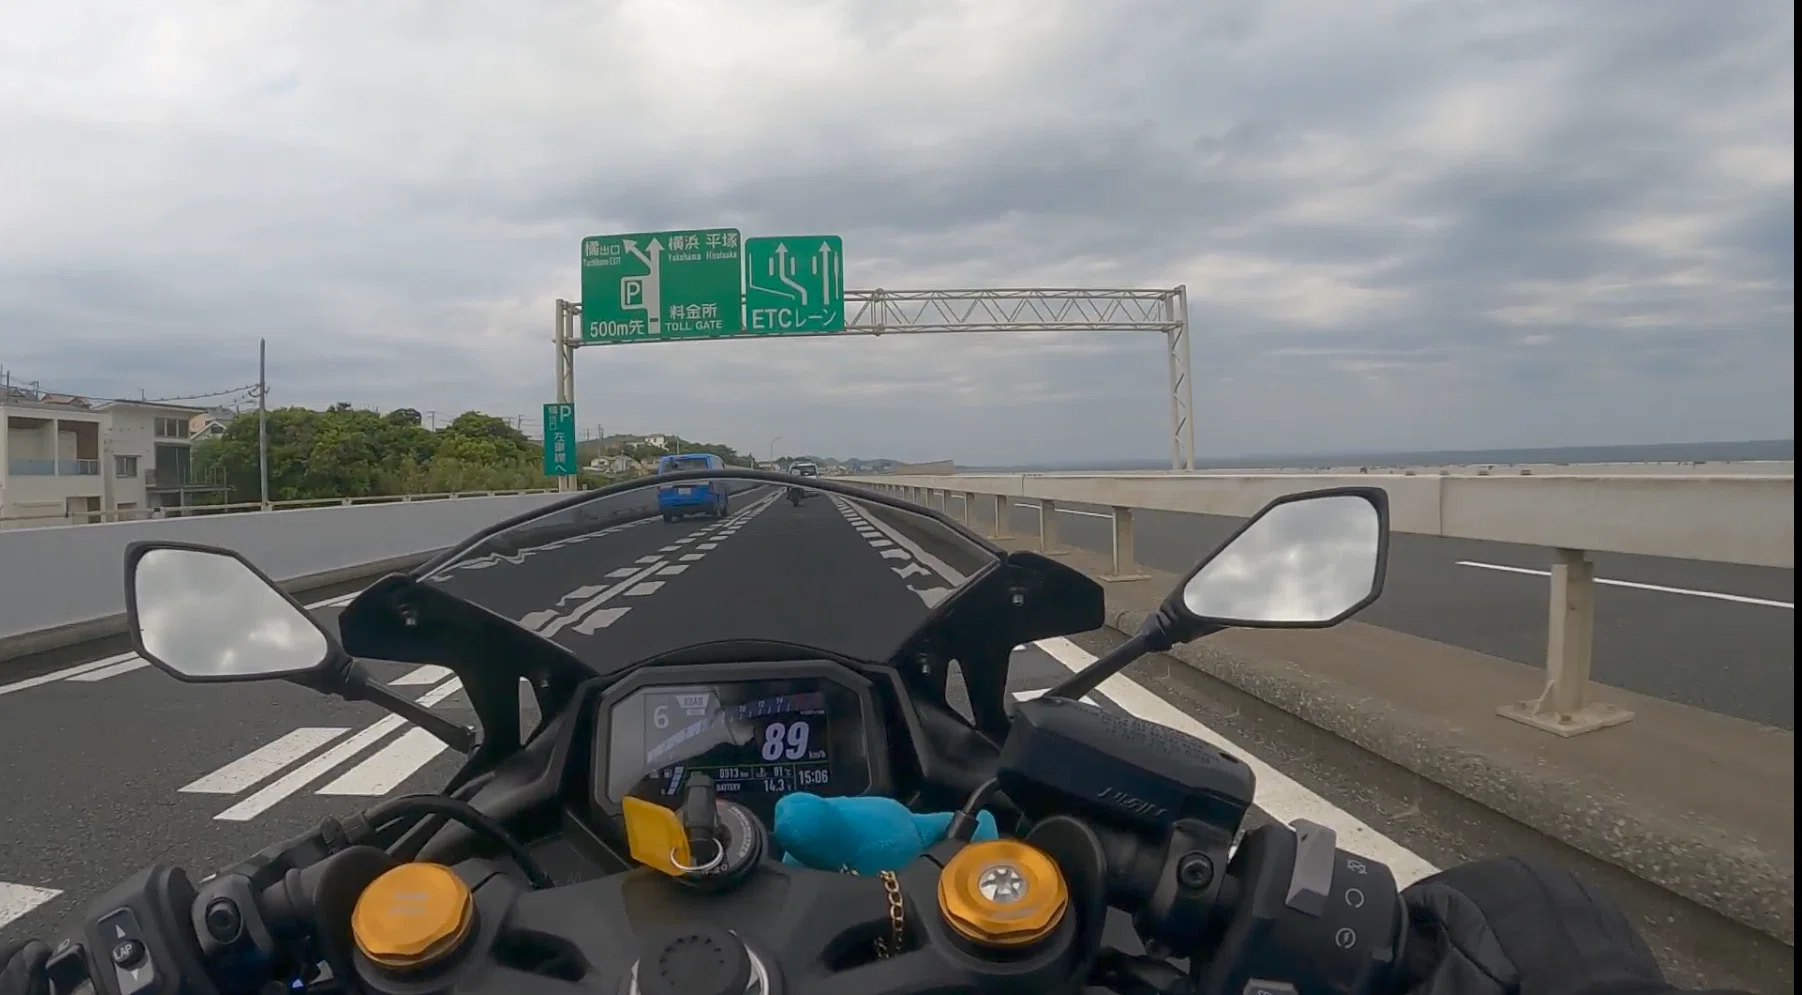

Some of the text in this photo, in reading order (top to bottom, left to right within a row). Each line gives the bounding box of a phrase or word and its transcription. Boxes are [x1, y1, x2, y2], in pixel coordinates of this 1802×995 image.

[668, 233, 738, 251] 横浜 平塚
[626, 282, 640, 304] P
[669, 303, 718, 319] 料金所
[752, 308, 837, 329] ETCレーン
[590, 320, 644, 337] 500m先
[666, 319, 723, 331] TOLL GATE
[560, 405, 571, 422] P
[653, 705, 669, 729] 6
[762, 721, 810, 761] 89
[763, 779, 785, 792] 14.3
[799, 770, 829, 785] 15:06
[716, 783, 741, 791] BATTERY
[113, 943, 132, 960] LAP
